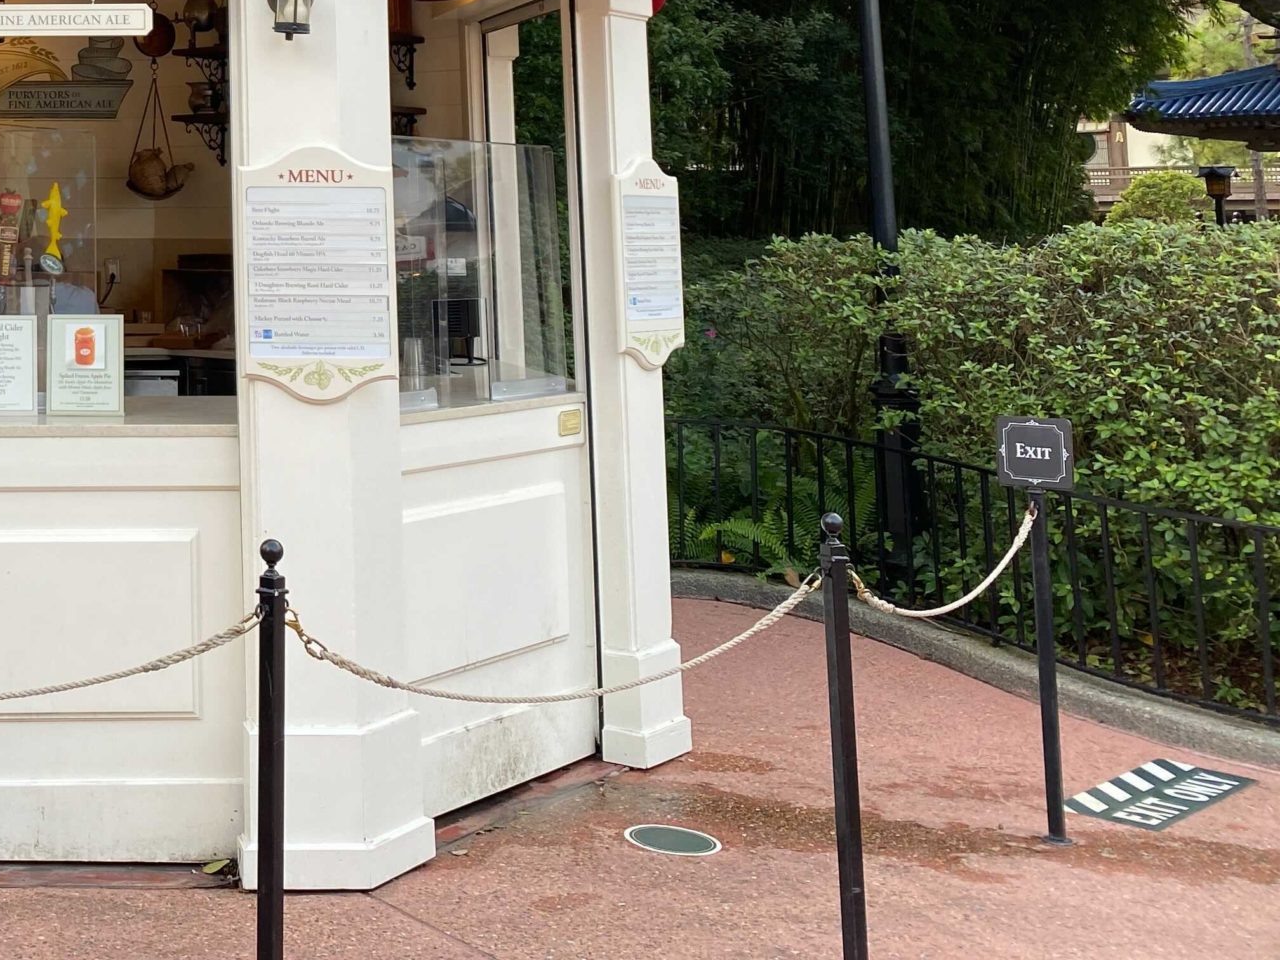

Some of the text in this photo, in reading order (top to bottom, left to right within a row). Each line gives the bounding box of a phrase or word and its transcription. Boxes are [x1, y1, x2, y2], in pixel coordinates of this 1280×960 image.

[28, 14, 102, 26] AMERICAN
[105, 14, 131, 25] ALE
[8, 90, 70, 99] PURVEYORS
[8, 99, 114, 109] FINE AMERICAN ALE
[288, 169, 344, 183] MENU
[639, 178, 662, 190] MENU
[1015, 442, 1052, 460] EXIT
[1112, 772, 1240, 826] EXIT ONLY
